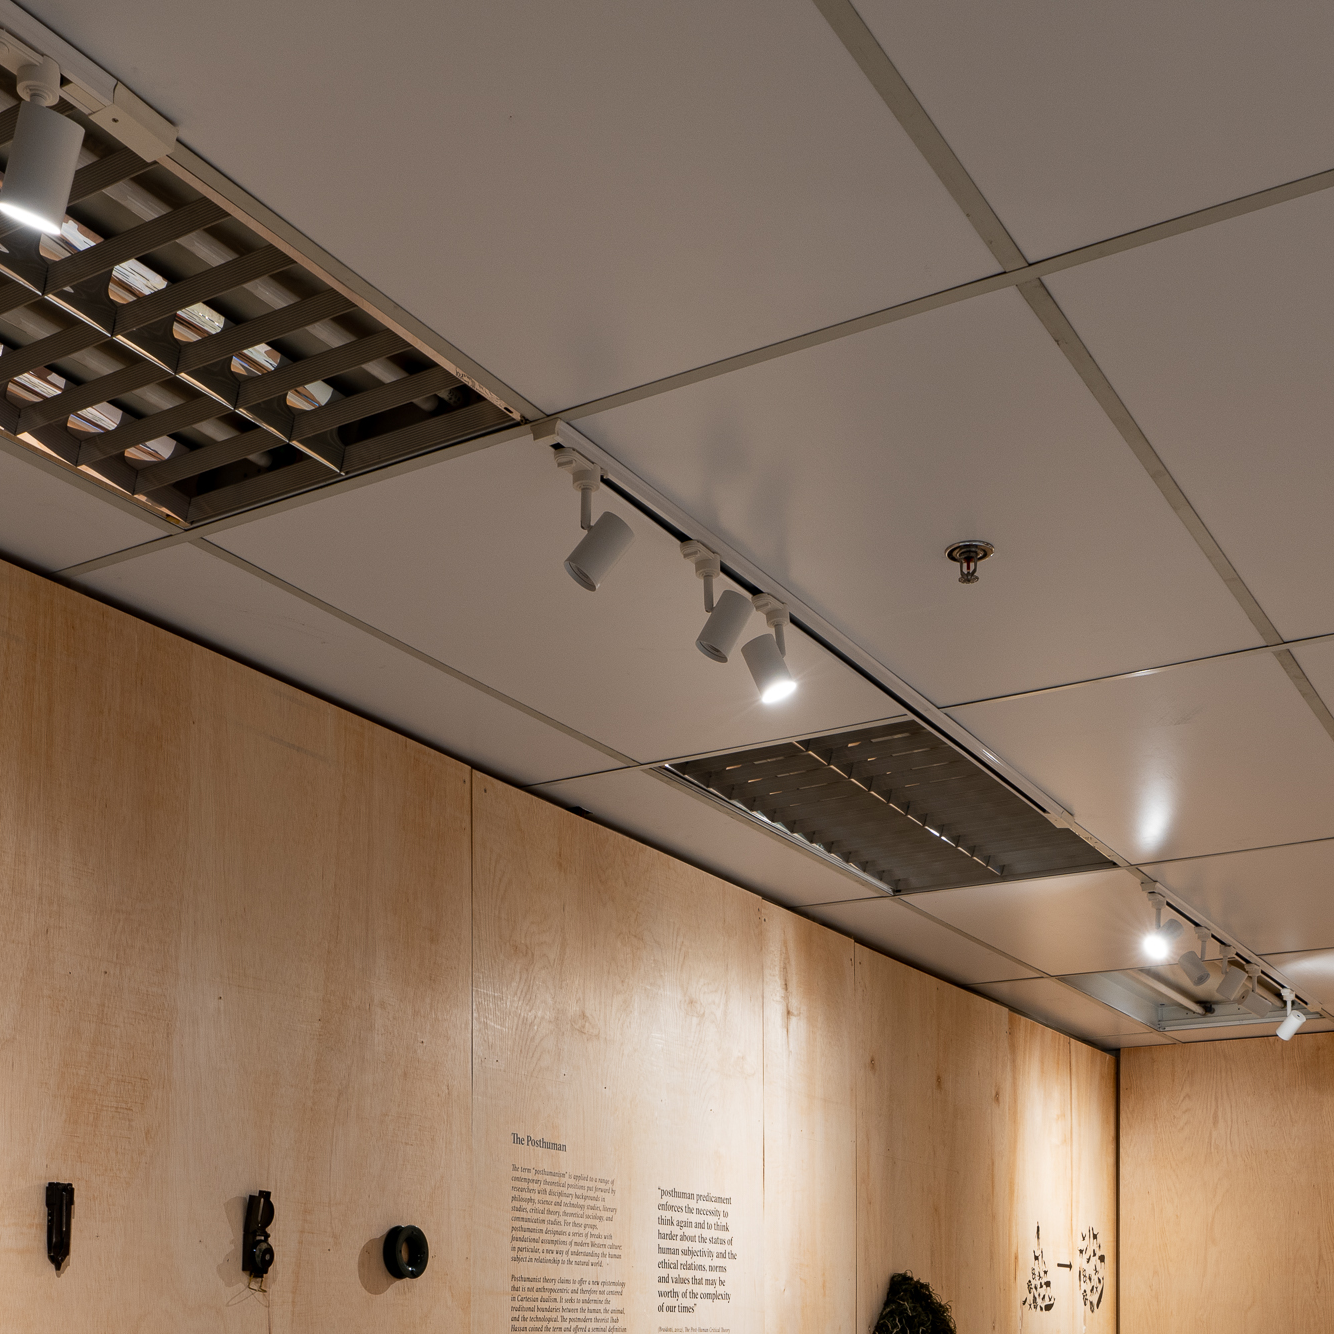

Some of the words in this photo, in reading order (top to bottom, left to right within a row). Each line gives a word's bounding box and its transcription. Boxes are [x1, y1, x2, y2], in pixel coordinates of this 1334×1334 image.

[511, 1133, 525, 1145] The
[526, 1135, 567, 1152] Posthuman
[696, 1193, 732, 1205] predicament
[658, 1201, 684, 1213] enforces
[684, 1204, 695, 1214] the
[696, 1207, 721, 1220] necessity
[723, 1210, 729, 1218] to
[658, 1215, 675, 1226] think
[676, 1218, 693, 1230] again
[694, 1220, 706, 1229] and
[706, 1222, 713, 1230] to
[714, 1221, 730, 1232] think
[658, 1229, 679, 1241] harder
[679, 1232, 697, 1243] about
[698, 1234, 708, 1244] the
[709, 1236, 727, 1245] status
[727, 1237, 734, 1246] of
[658, 1244, 680, 1255] human
[681, 1246, 714, 1261] subjectivity
[716, 1250, 727, 1259] and
[728, 1250, 738, 1260] the
[658, 1259, 679, 1270] ethical
[658, 1274, 670, 1283] and
[671, 1274, 691, 1284] values
[691, 1275, 704, 1285] that
[705, 1279, 717, 1289] may
[719, 1277, 726, 1286] be
[658, 1288, 681, 1301] worthy
[681, 1289, 689, 1299] of
[689, 1289, 699, 1299] the
[700, 1290, 731, 1303] complexity
[658, 1302, 665, 1312] of
[665, 1305, 677, 1313] our
